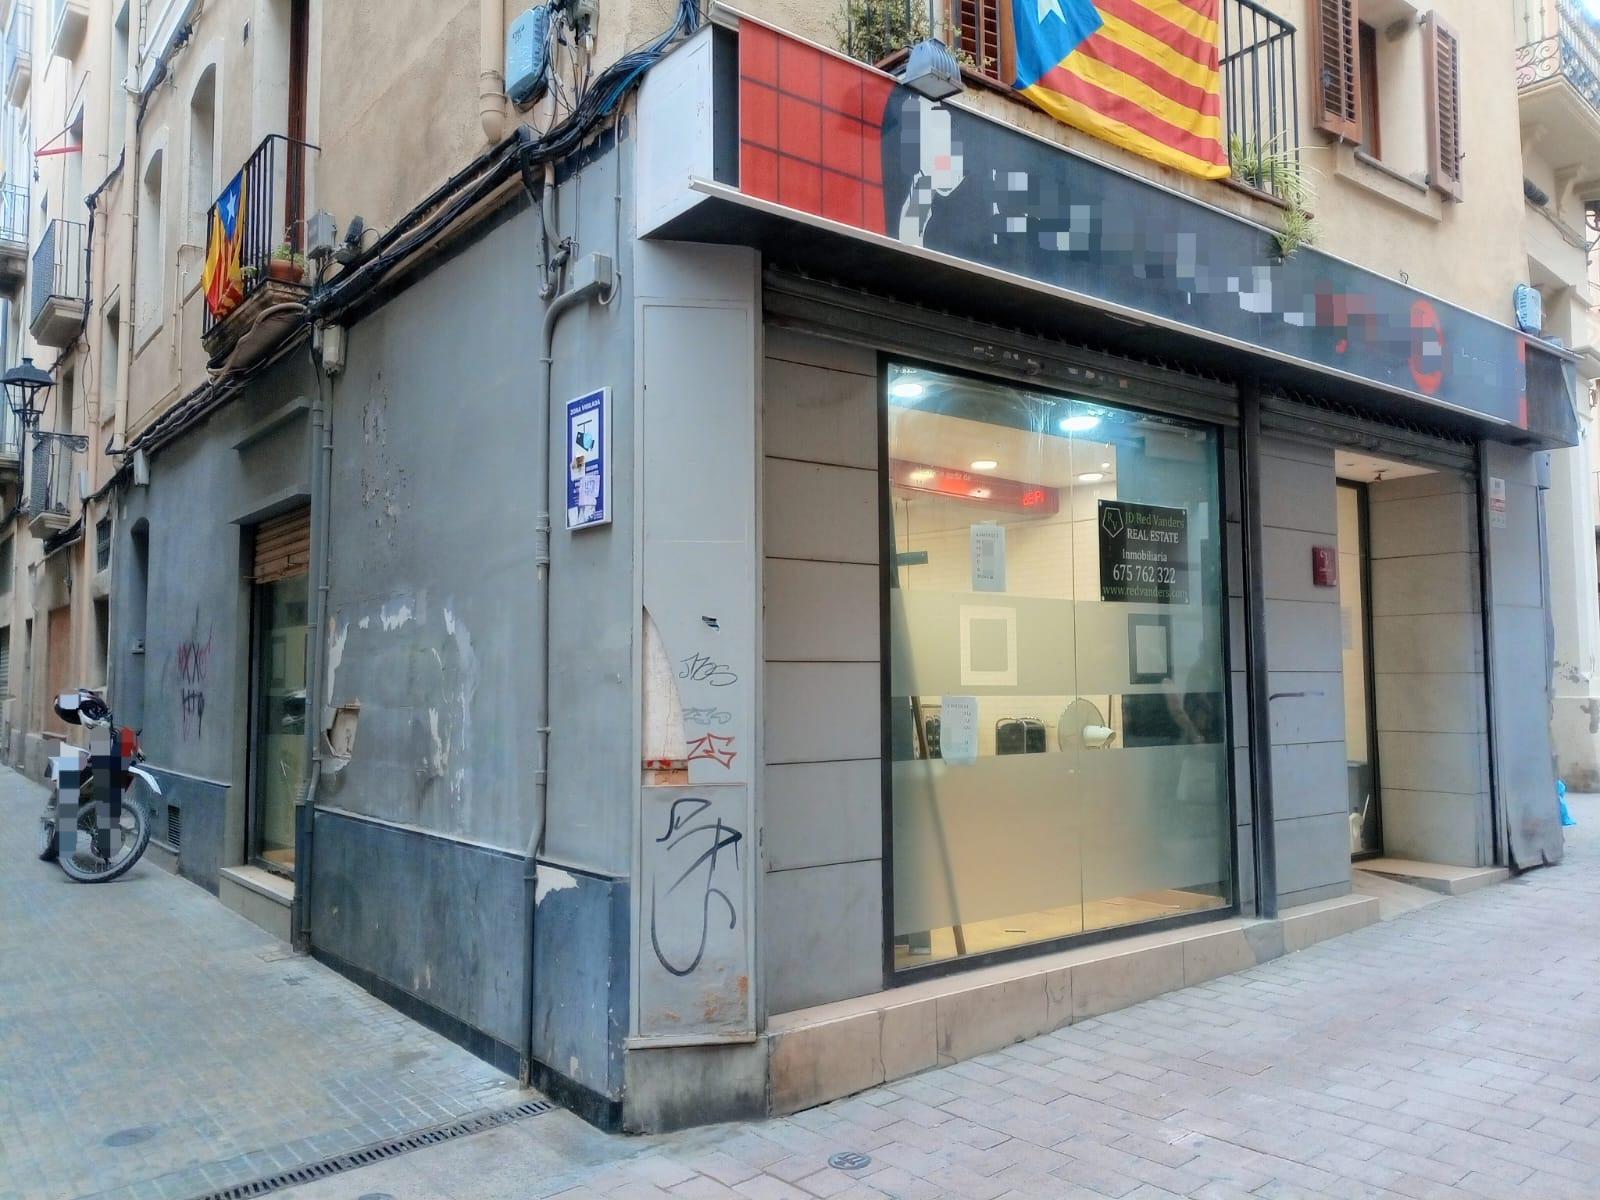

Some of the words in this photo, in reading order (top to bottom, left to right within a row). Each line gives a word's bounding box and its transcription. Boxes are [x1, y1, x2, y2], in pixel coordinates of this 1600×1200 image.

[1136, 512, 1152, 525] Red
[1152, 514, 1185, 528] Vanders
[1127, 528, 1149, 541] REAL
[1150, 530, 1179, 544] ESTATE
[1122, 548, 1168, 562] Inmobiliaria
[1113, 563, 1133, 581] 675
[1135, 565, 1155, 583] 762
[1157, 566, 1176, 584] 322
